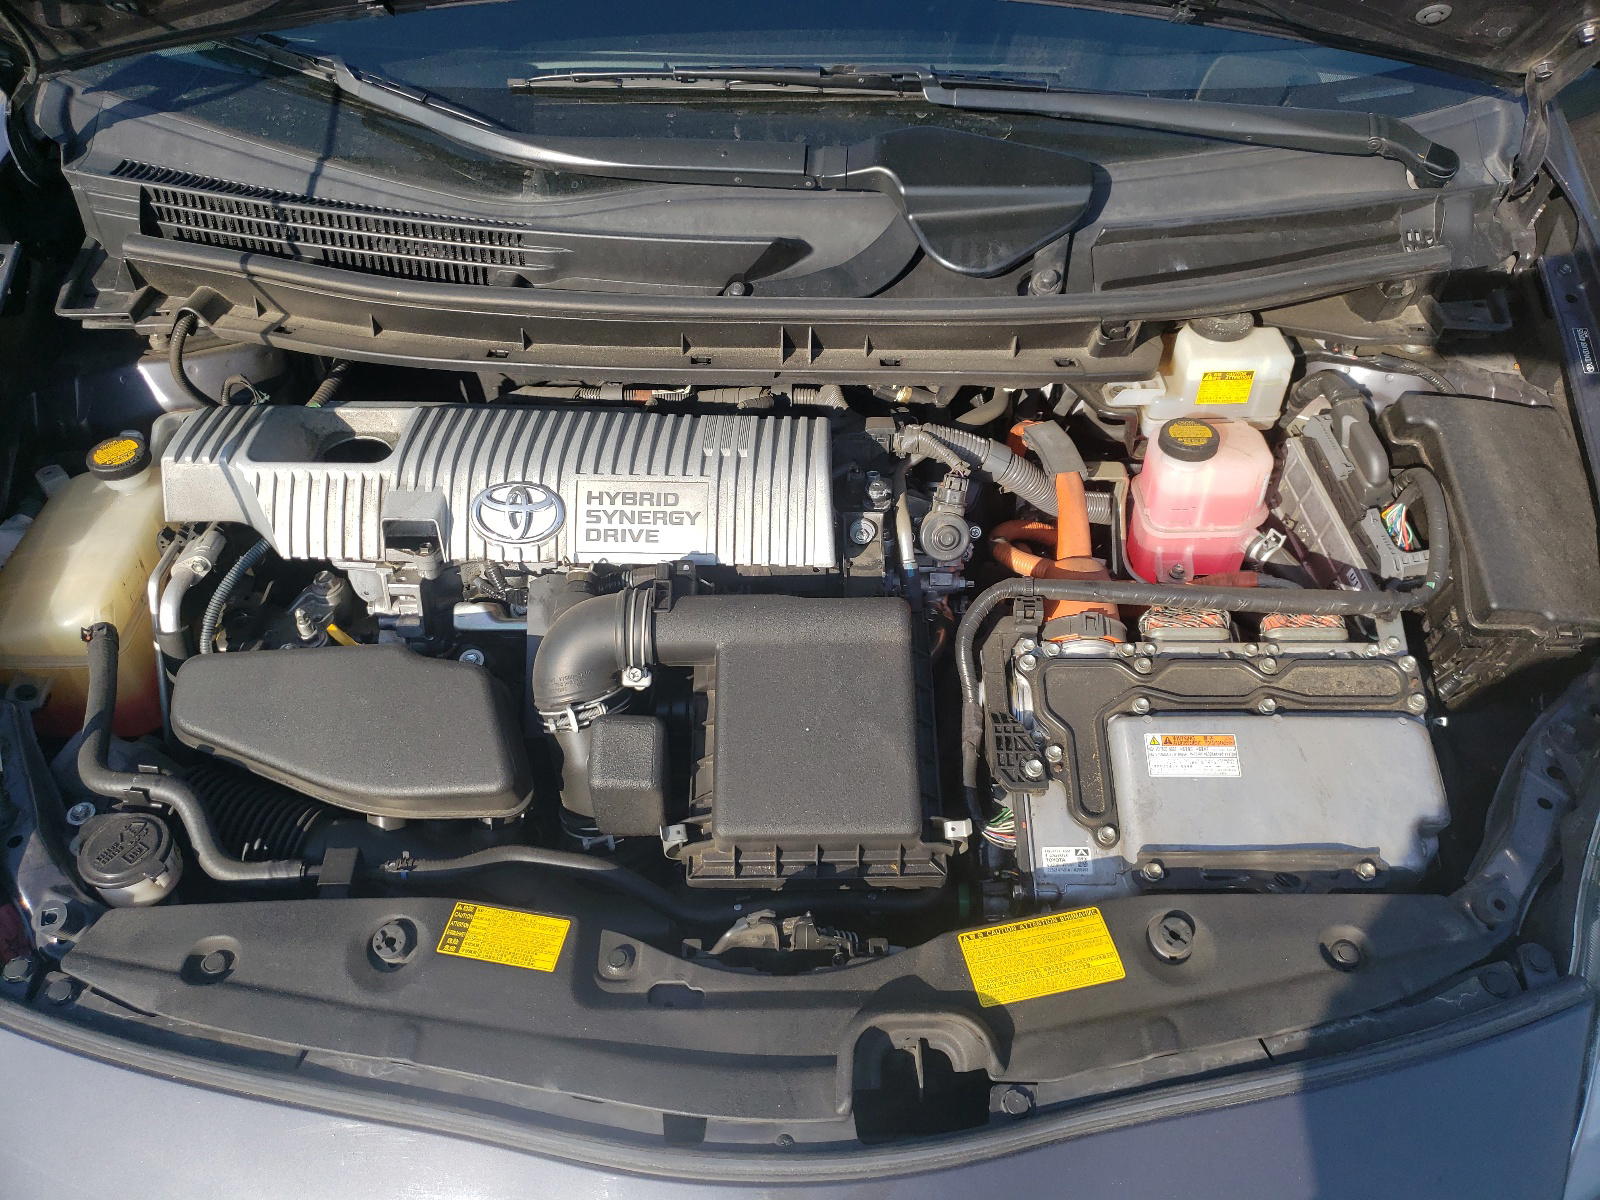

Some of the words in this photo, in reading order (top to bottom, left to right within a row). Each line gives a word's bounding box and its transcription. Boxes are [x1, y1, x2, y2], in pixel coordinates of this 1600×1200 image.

[586, 490, 680, 507] HYBRID
[585, 509, 702, 526] SYNERGY
[585, 528, 660, 543] DRIVE
[987, 926, 1016, 937] CAUTION
[1019, 917, 1058, 929] ATTENTION
